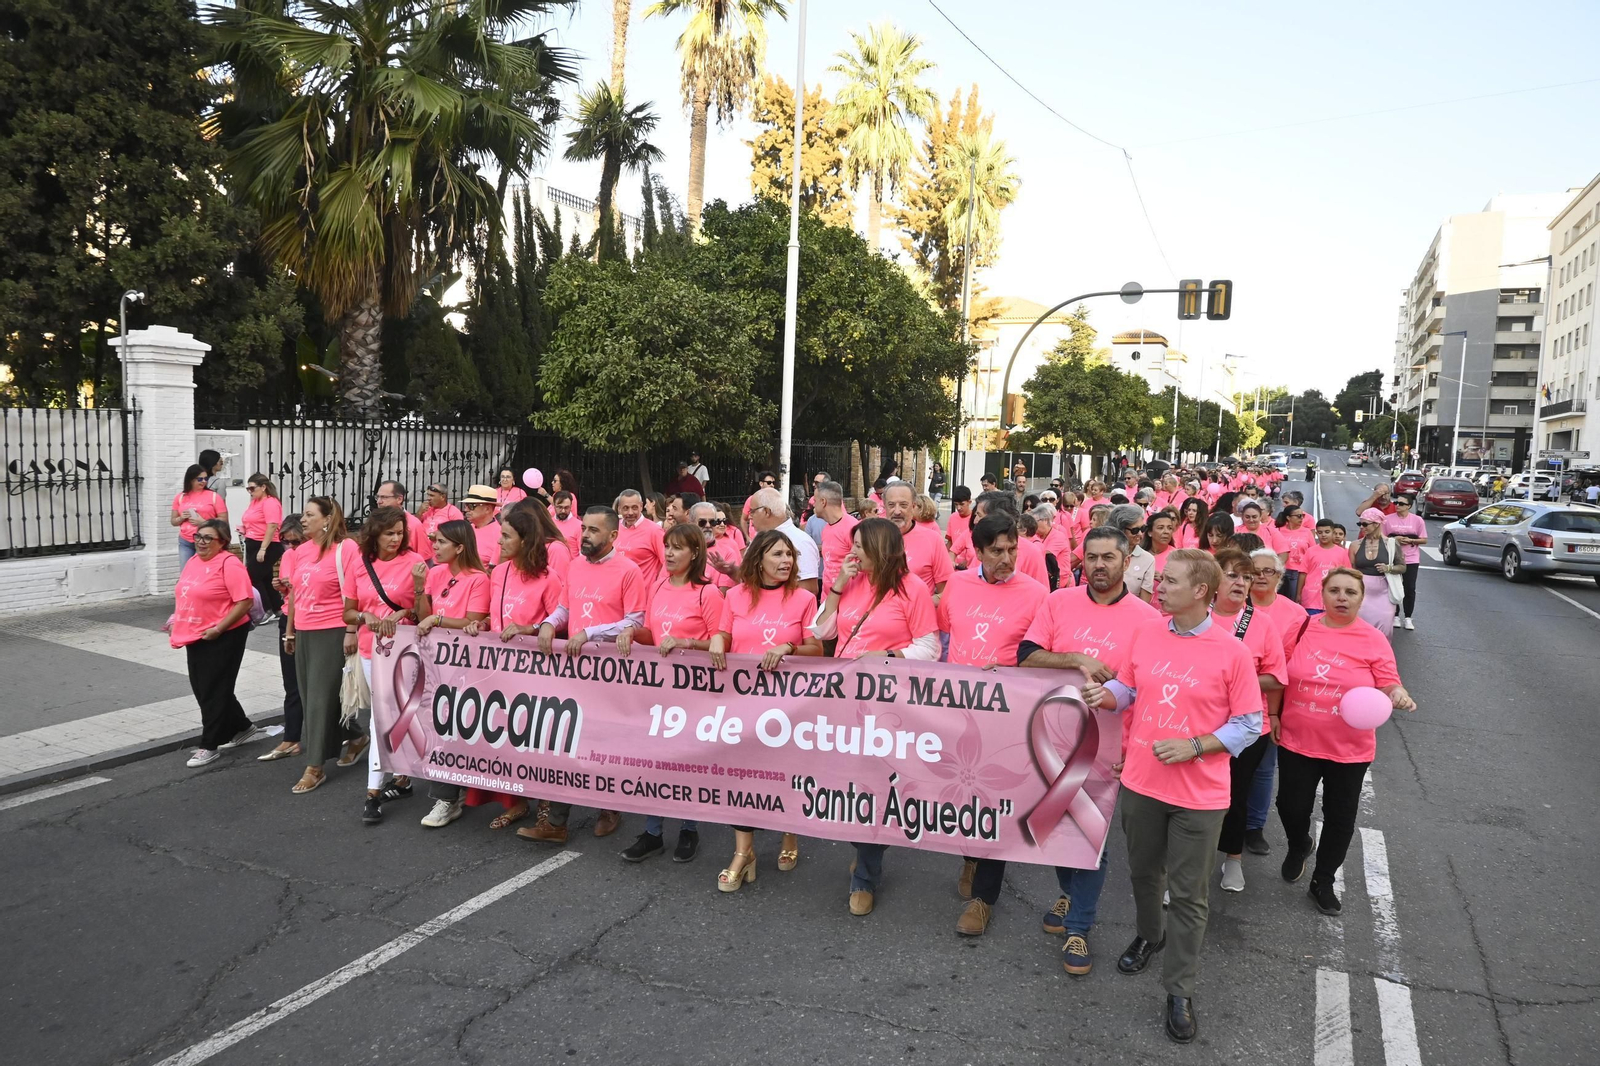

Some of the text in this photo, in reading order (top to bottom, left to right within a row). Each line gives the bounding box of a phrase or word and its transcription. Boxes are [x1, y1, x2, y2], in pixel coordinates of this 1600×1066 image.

[8, 457, 110, 475] CASONA
[752, 613, 792, 629] Unidos
[965, 604, 1005, 624] Unidos
[1073, 626, 1118, 651] Unidos
[971, 644, 998, 664] Vida
[434, 636, 1010, 713] DÍA INTERNACIONAL DEL CÁNCER DE MAMA
[1151, 661, 1200, 688] Unidos
[433, 684, 582, 757] aocam
[1158, 711, 1190, 735] Vida
[648, 704, 943, 763] 19 de Octubre
[428, 768, 524, 793] www.aocamhuelva.es
[609, 754, 622, 765] un
[623, 756, 654, 769] nuevo
[655, 759, 709, 775] amanecer
[711, 763, 725, 776] de
[727, 766, 786, 782] esperanza
[429, 750, 785, 813] ASOCIACIÓN ONUBENSE DE CÁNCER DE MAMA
